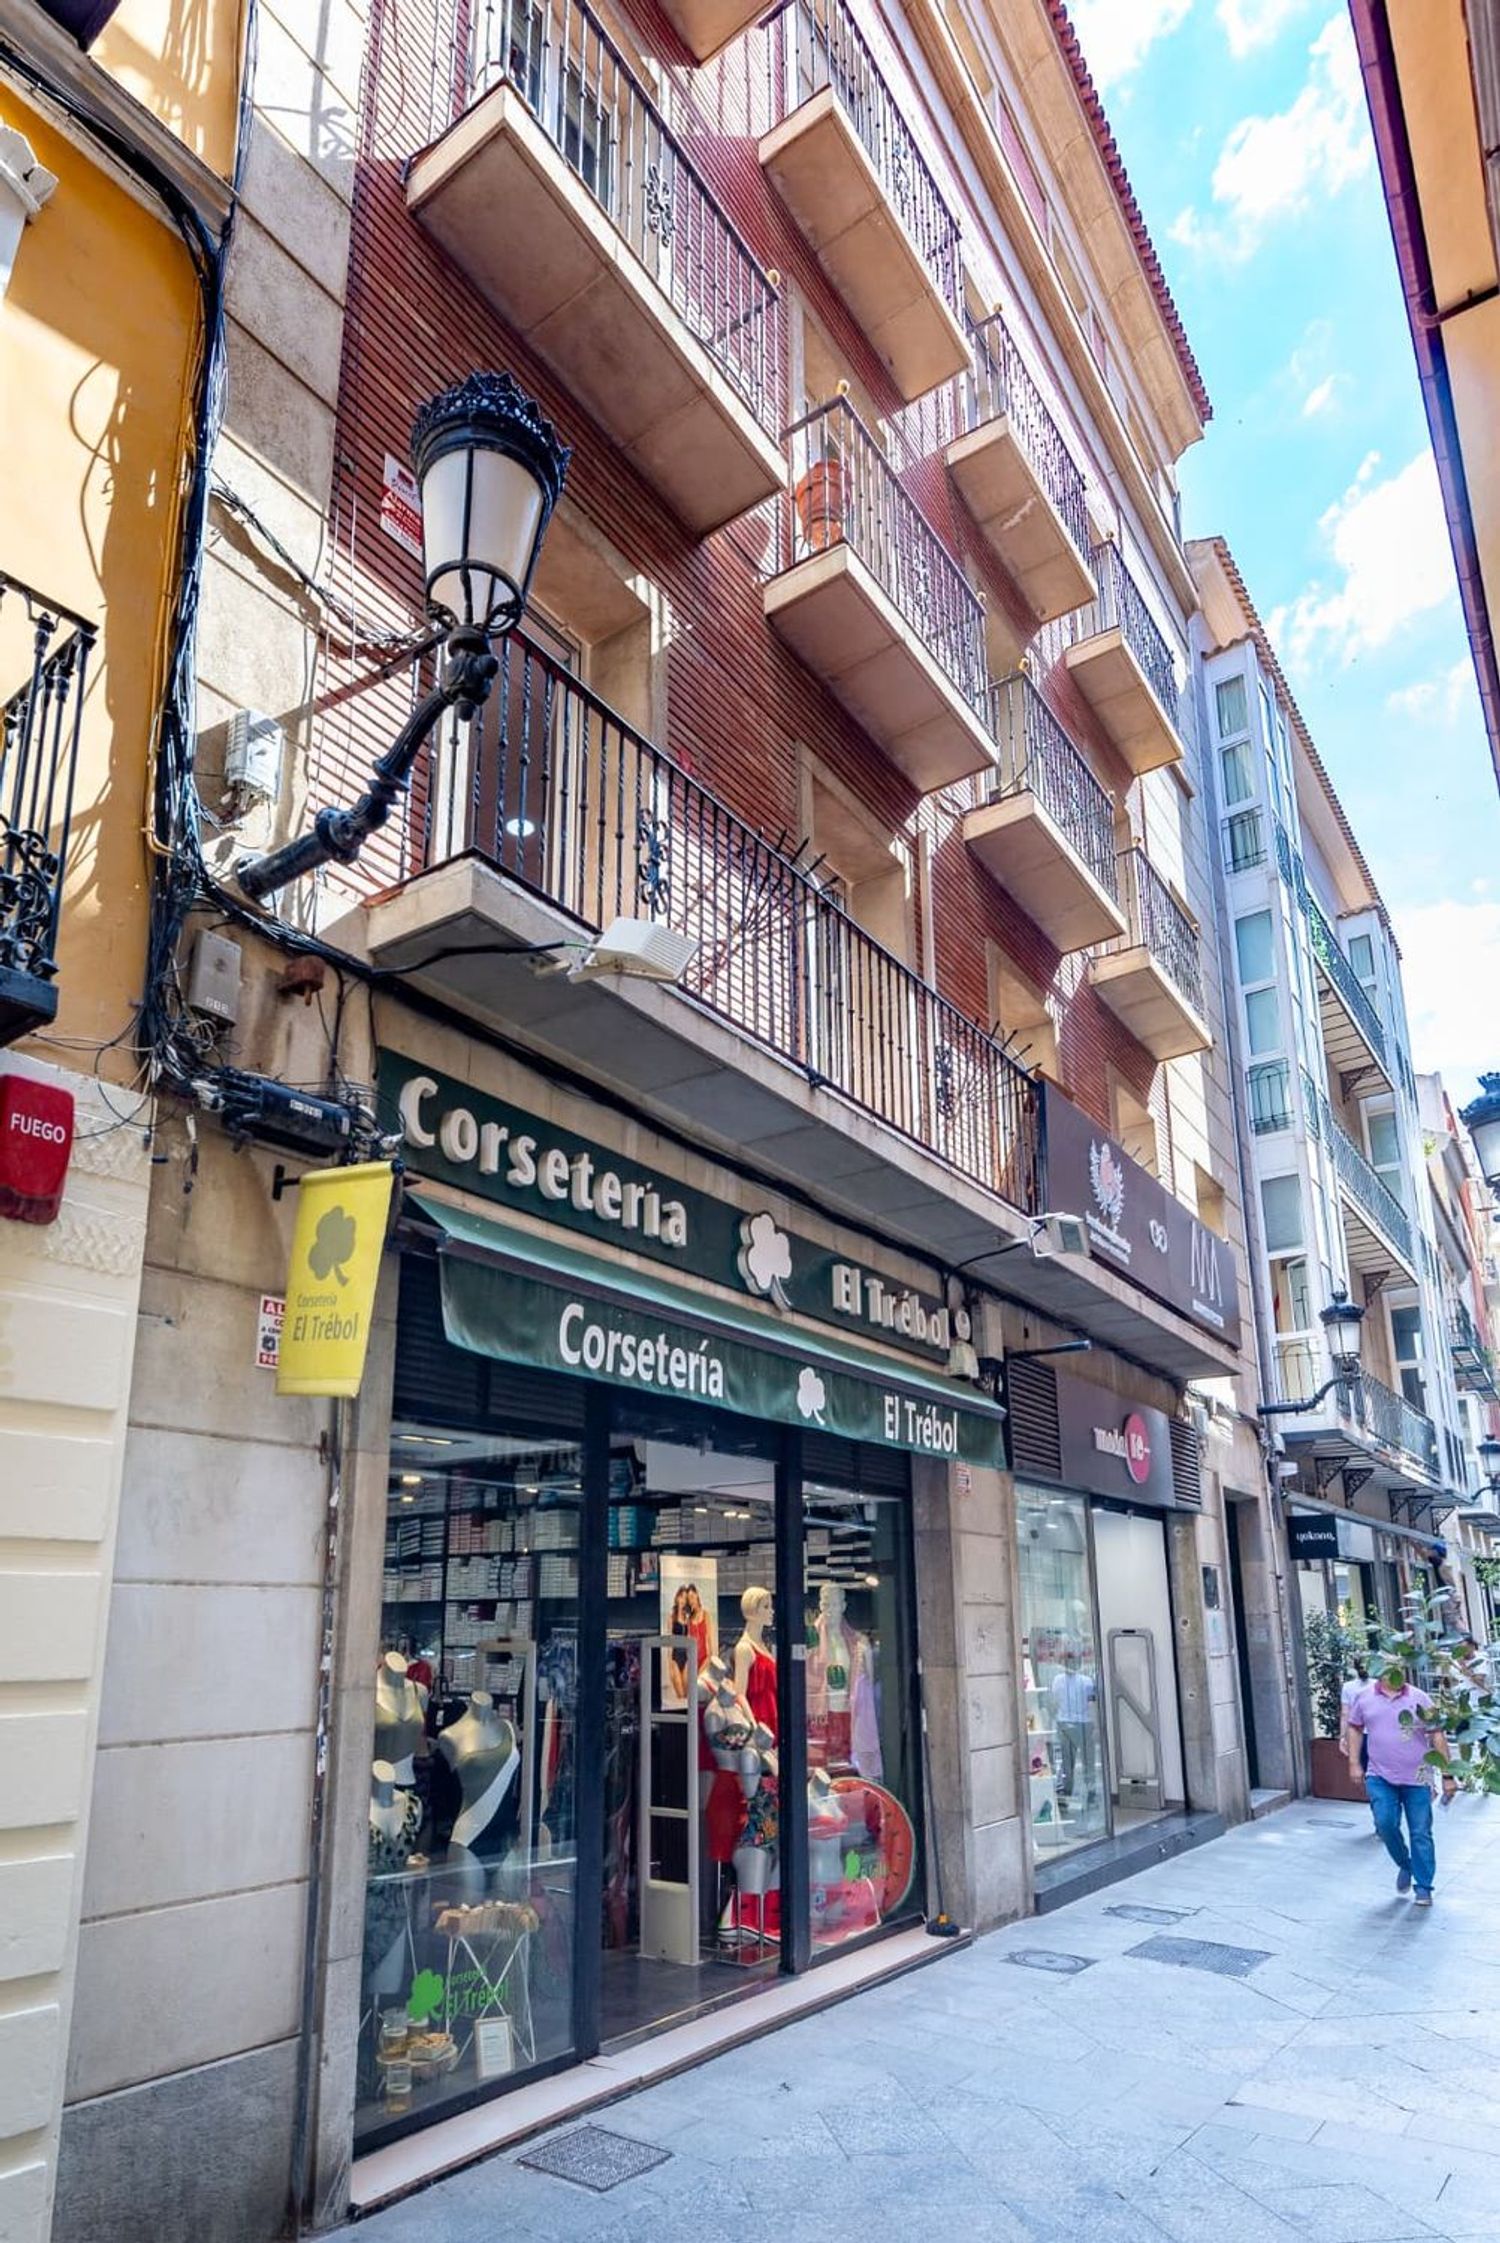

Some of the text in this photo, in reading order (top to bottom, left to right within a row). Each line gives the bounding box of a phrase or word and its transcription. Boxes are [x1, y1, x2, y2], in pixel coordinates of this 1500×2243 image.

[10, 1113, 66, 1144] FUEGO
[399, 1076, 687, 1247] Corsetería
[293, 1312, 358, 1341] El Trébol
[832, 1264, 951, 1350] El Trébol
[559, 1303, 724, 1398] Corsetería
[884, 1395, 958, 1454] El Trébol
